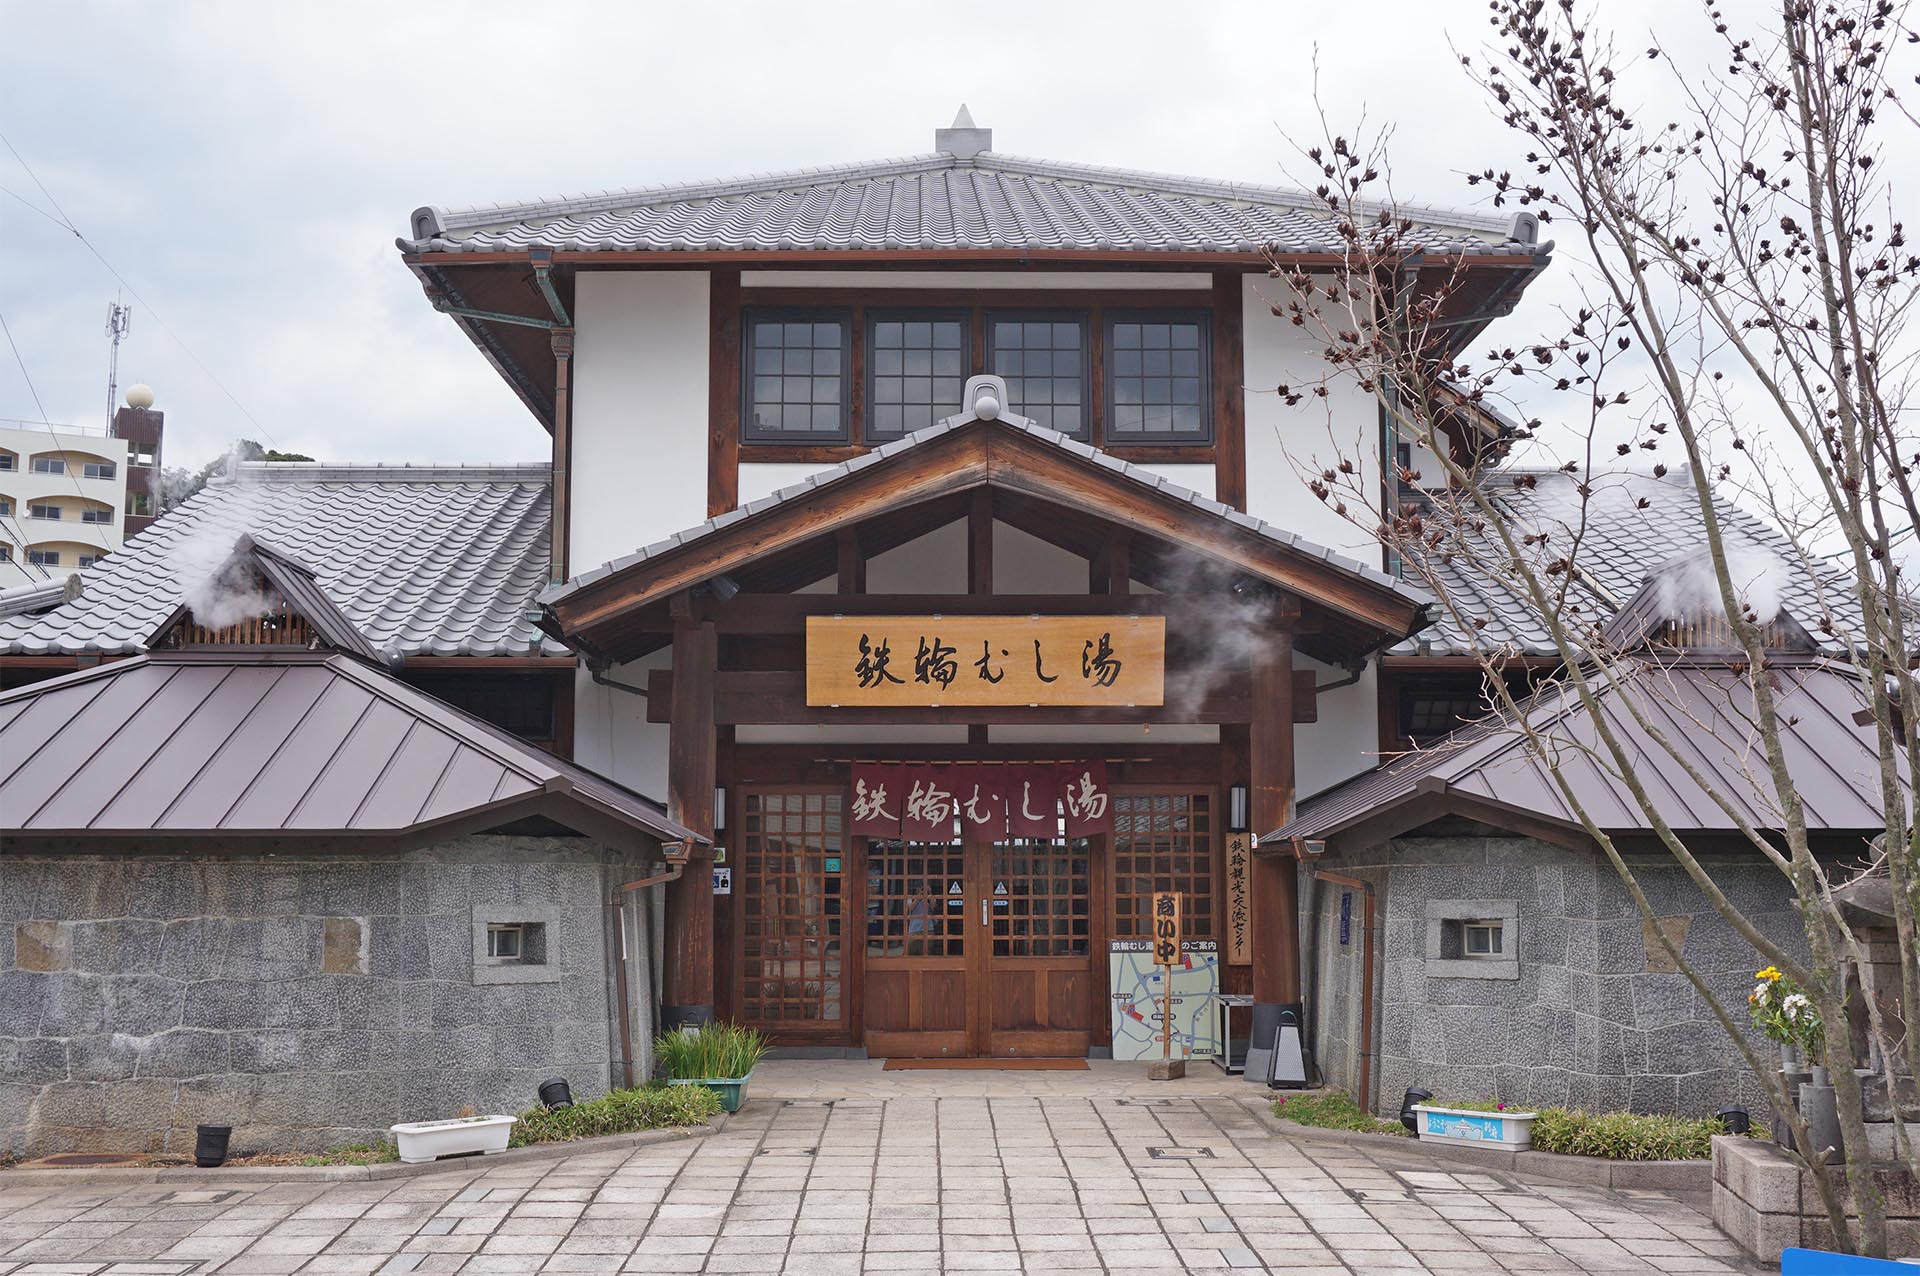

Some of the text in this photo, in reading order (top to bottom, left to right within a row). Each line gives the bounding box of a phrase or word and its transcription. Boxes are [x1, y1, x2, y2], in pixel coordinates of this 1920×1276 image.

[854, 632, 1122, 691] 鉄輪むし湯
[851, 771, 1109, 828] 鉄輪むし湯
[1157, 895, 1176, 962] 商い中
[1229, 838, 1248, 957] 鉄輪観光交流センター
